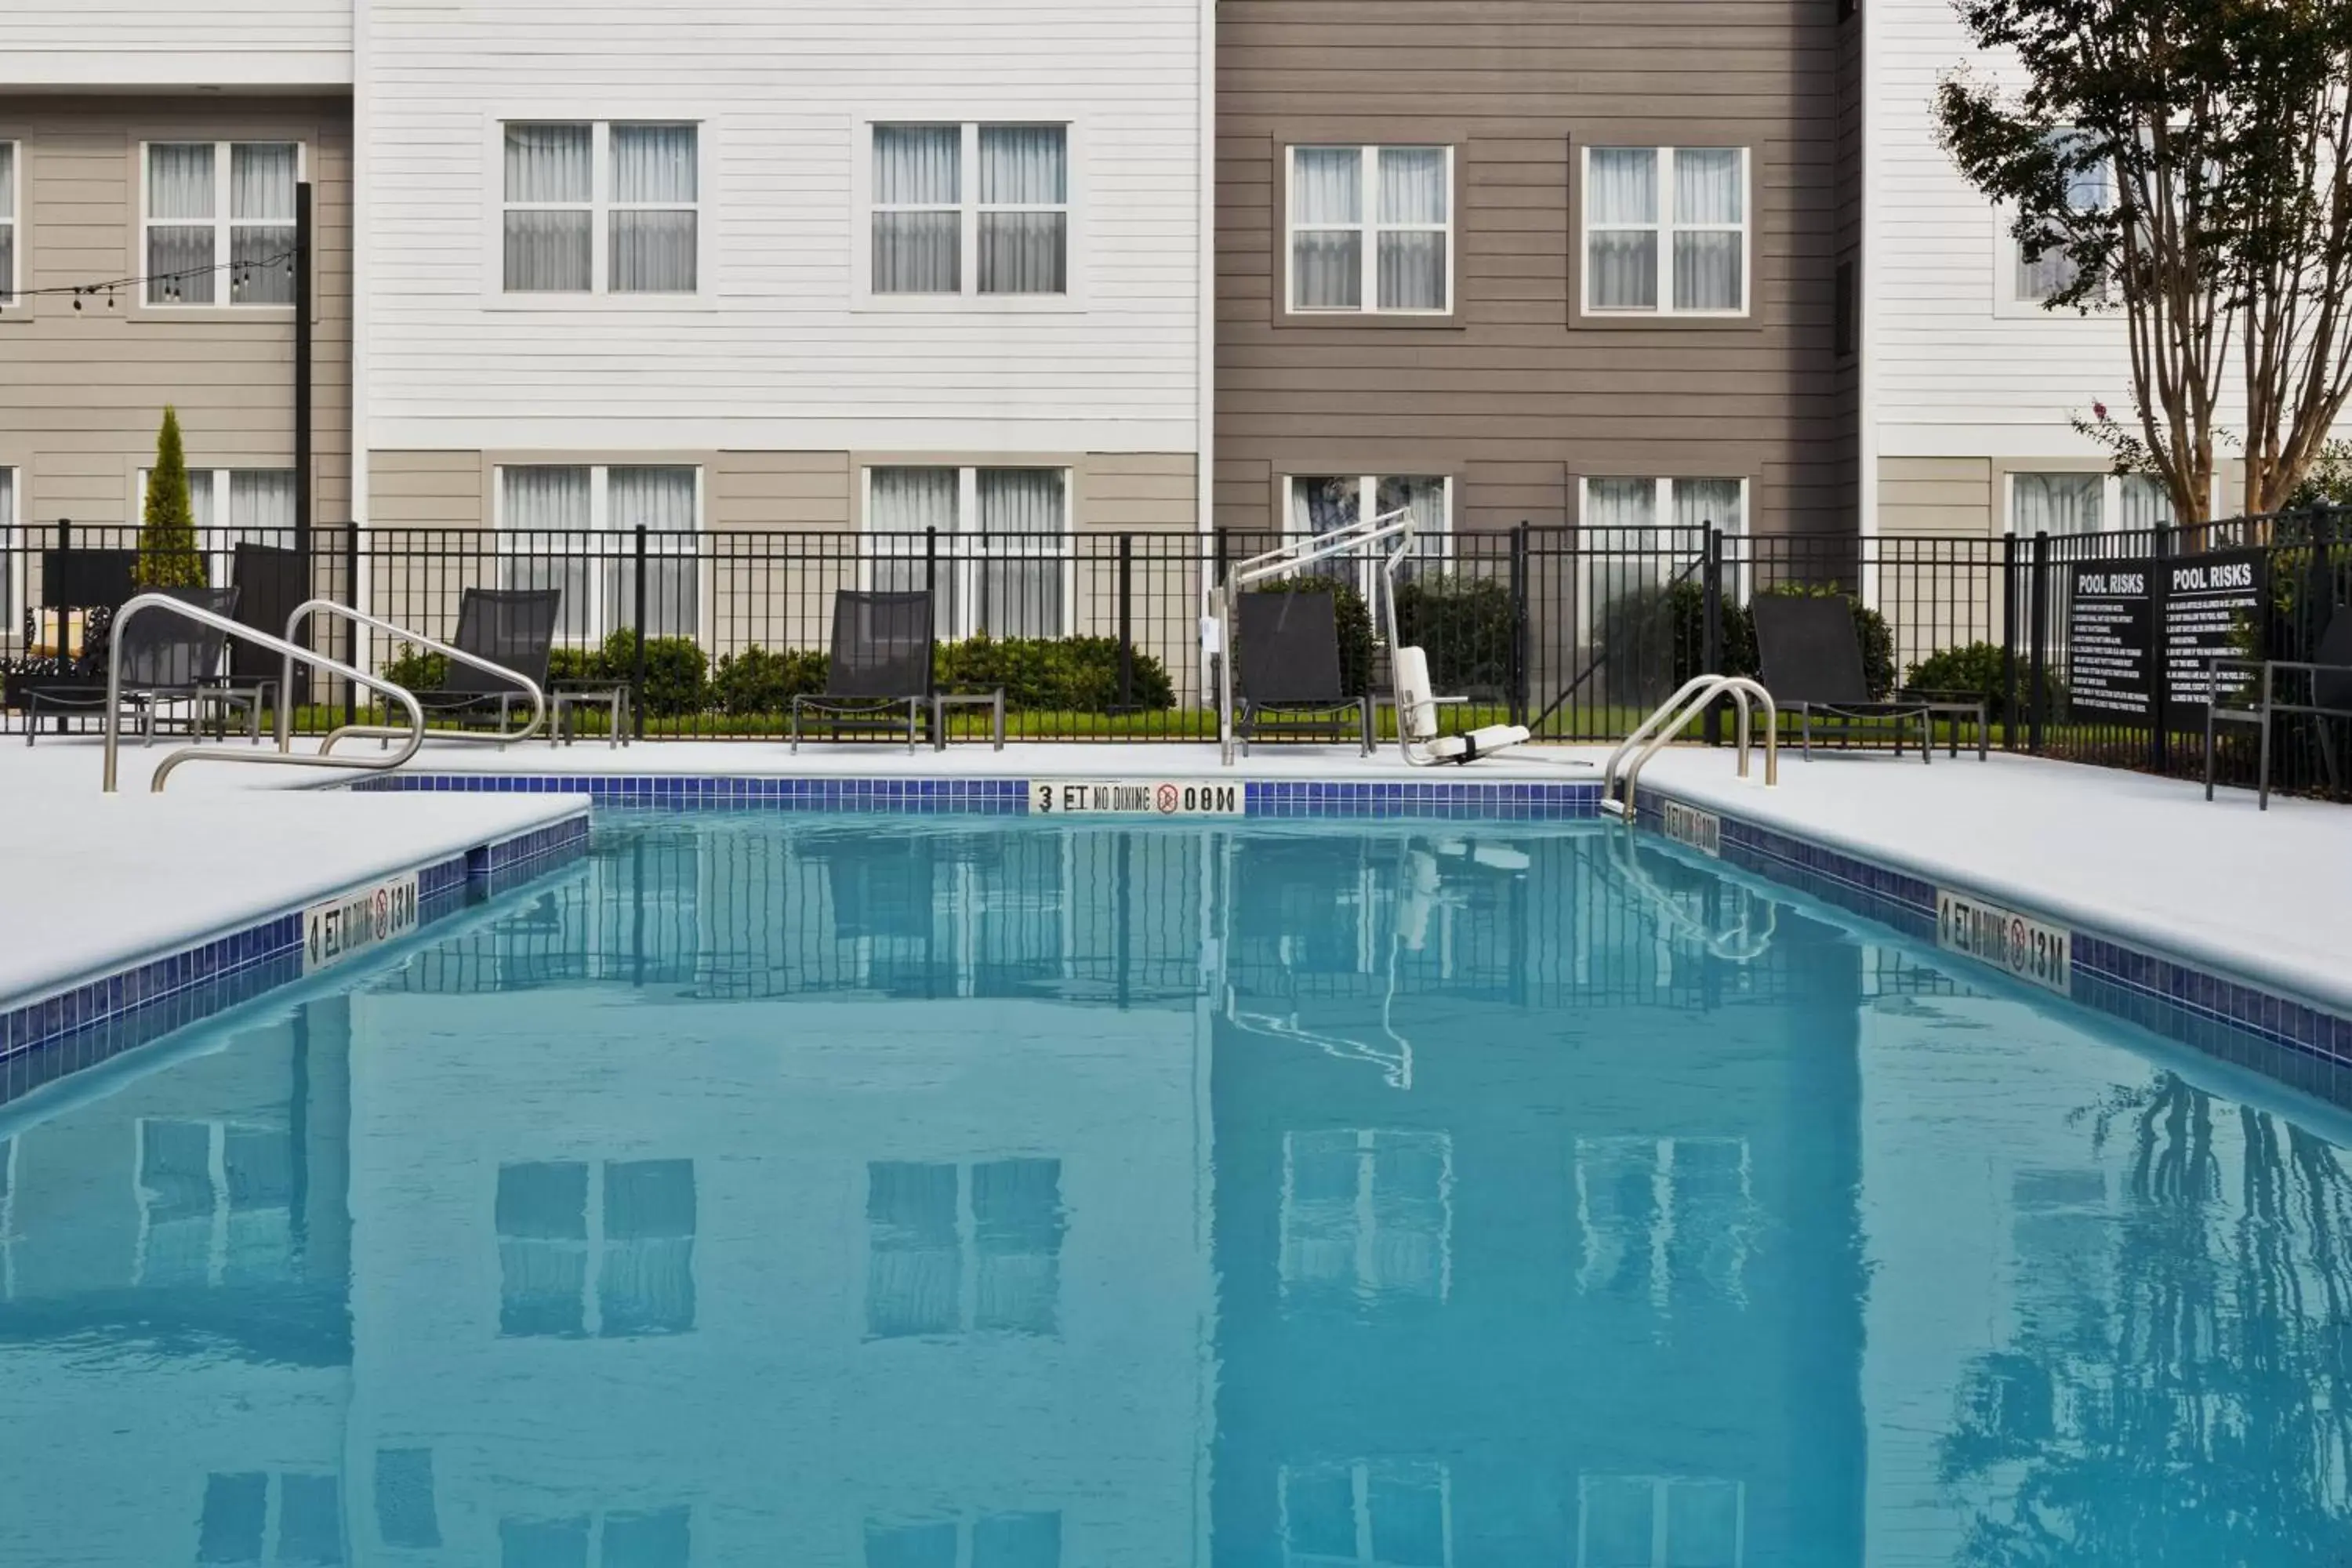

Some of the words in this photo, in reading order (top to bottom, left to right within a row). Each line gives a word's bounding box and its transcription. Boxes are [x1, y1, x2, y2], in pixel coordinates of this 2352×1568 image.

[2078, 575, 2107, 593] POOL
[2110, 574, 2144, 593] RISKS
[2173, 568, 2207, 590] POOL
[2211, 563, 2251, 586] RISKS
[1038, 786, 1053, 812] 3
[1094, 786, 1108, 810] NO
